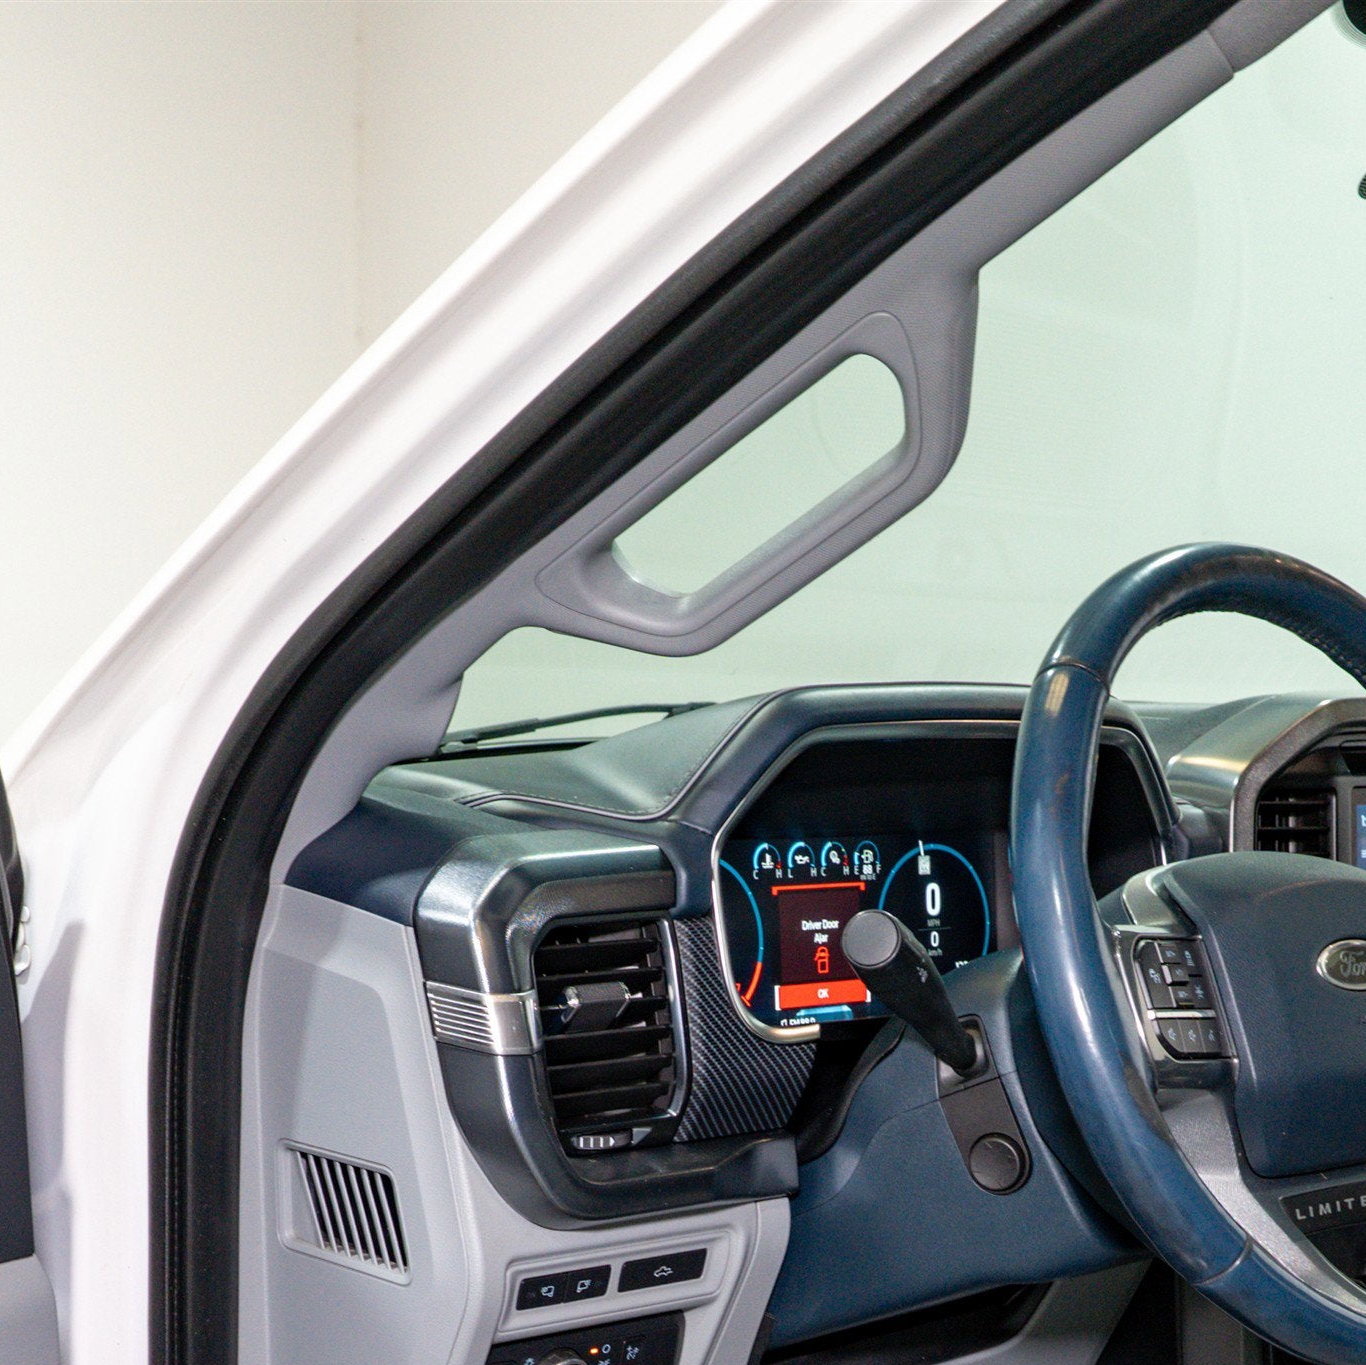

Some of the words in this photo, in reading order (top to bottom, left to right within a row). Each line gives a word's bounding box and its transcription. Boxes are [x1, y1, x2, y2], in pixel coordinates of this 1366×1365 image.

[775, 868, 783, 879] H
[810, 866, 817, 877] H
[843, 865, 850, 876] H
[926, 882, 941, 916] 0
[801, 920, 822, 931] Driver
[822, 919, 840, 929] Door
[813, 932, 829, 944] Ajar
[930, 931, 940, 947] 0
[817, 988, 830, 999] OK
